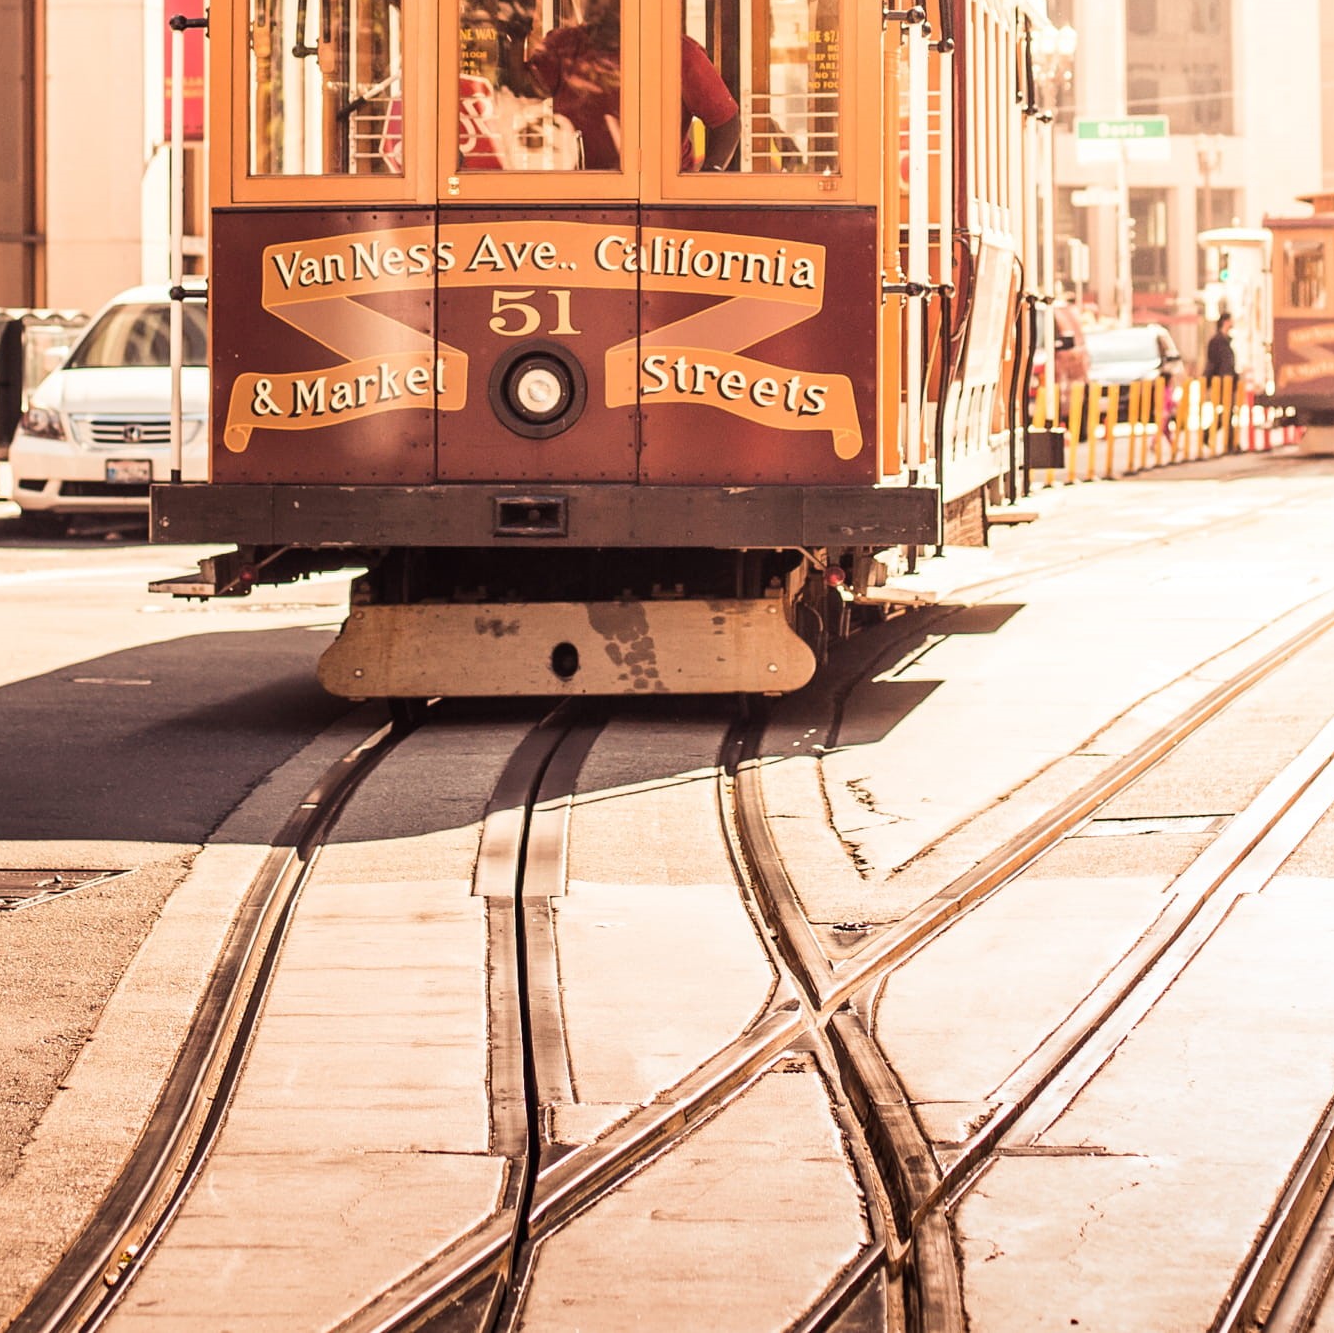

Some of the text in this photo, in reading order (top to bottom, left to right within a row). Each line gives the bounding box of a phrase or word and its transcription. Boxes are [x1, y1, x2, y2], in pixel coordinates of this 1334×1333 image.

[594, 234, 817, 290] California
[489, 289, 582, 337] 51
[251, 358, 448, 419] & Market
[641, 353, 830, 416] Streets
